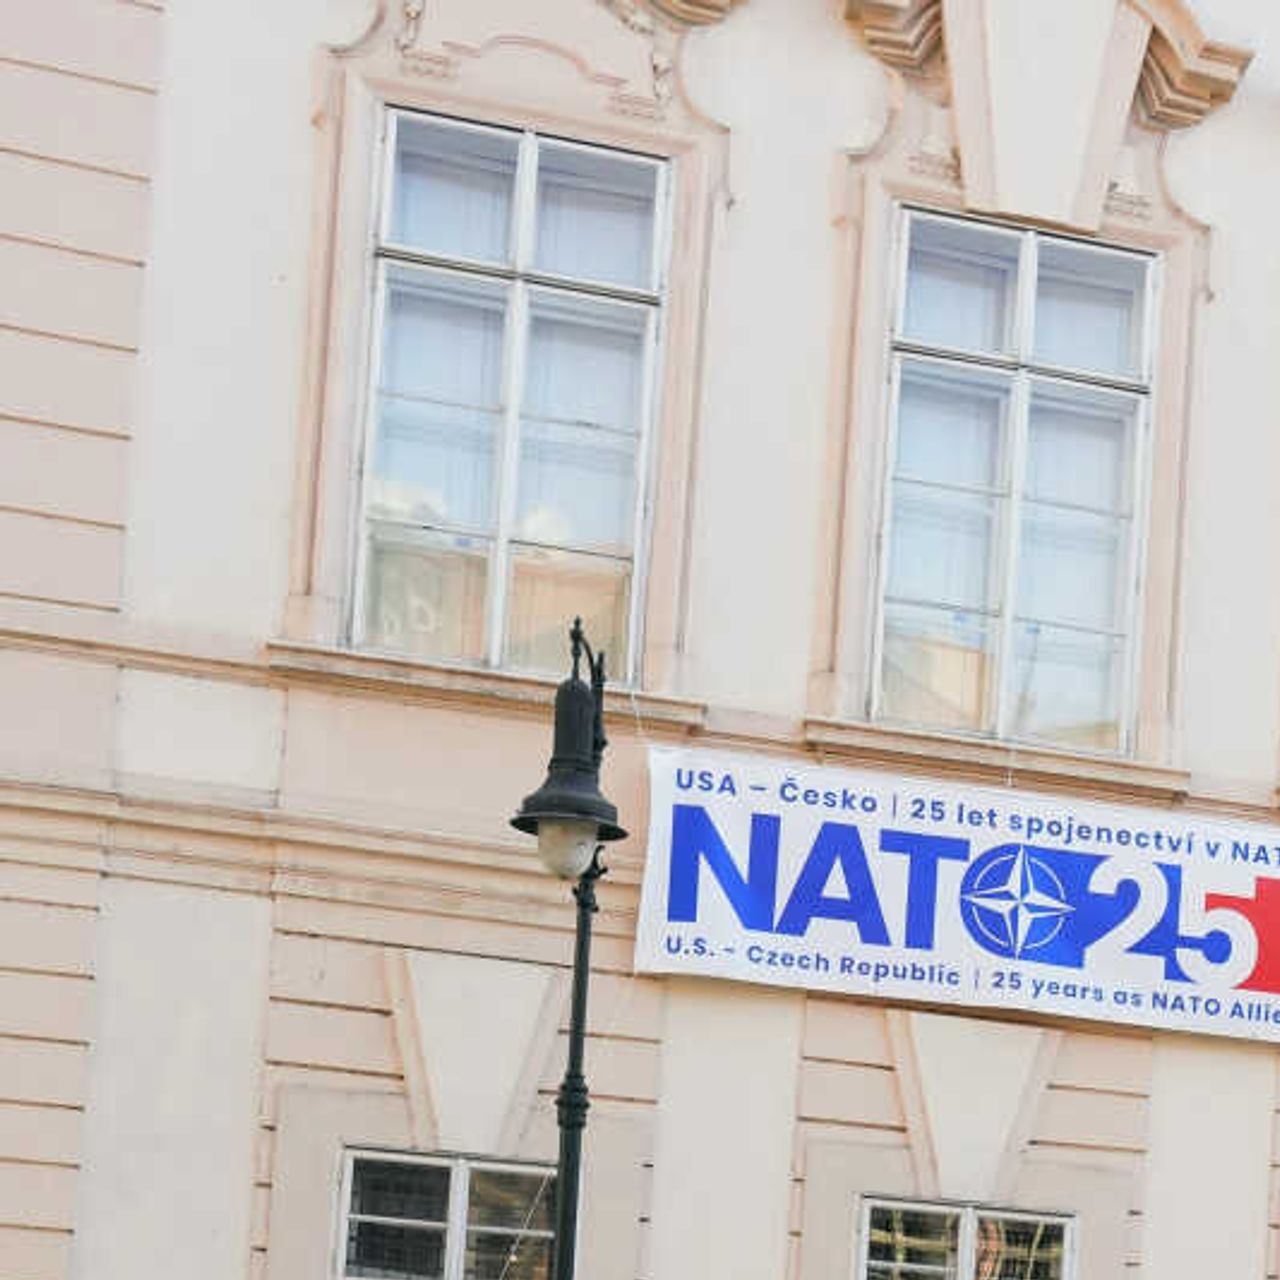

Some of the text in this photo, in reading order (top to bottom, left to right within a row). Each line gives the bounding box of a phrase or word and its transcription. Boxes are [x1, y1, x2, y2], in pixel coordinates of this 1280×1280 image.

[676, 767, 737, 797] USA
[780, 776, 878, 813] Česko
[910, 798, 945, 823] 25
[957, 802, 998, 828] let
[1009, 813, 1194, 852] spojenectví
[1206, 840, 1221, 859] v
[666, 936, 716, 956] U.S.
[747, 944, 829, 971] Czech
[840, 956, 961, 985] Republic
[992, 972, 1022, 991] 25
[1032, 977, 1104, 1001] years
[1113, 989, 1143, 1008] as
[1151, 993, 1222, 1017] NATO
